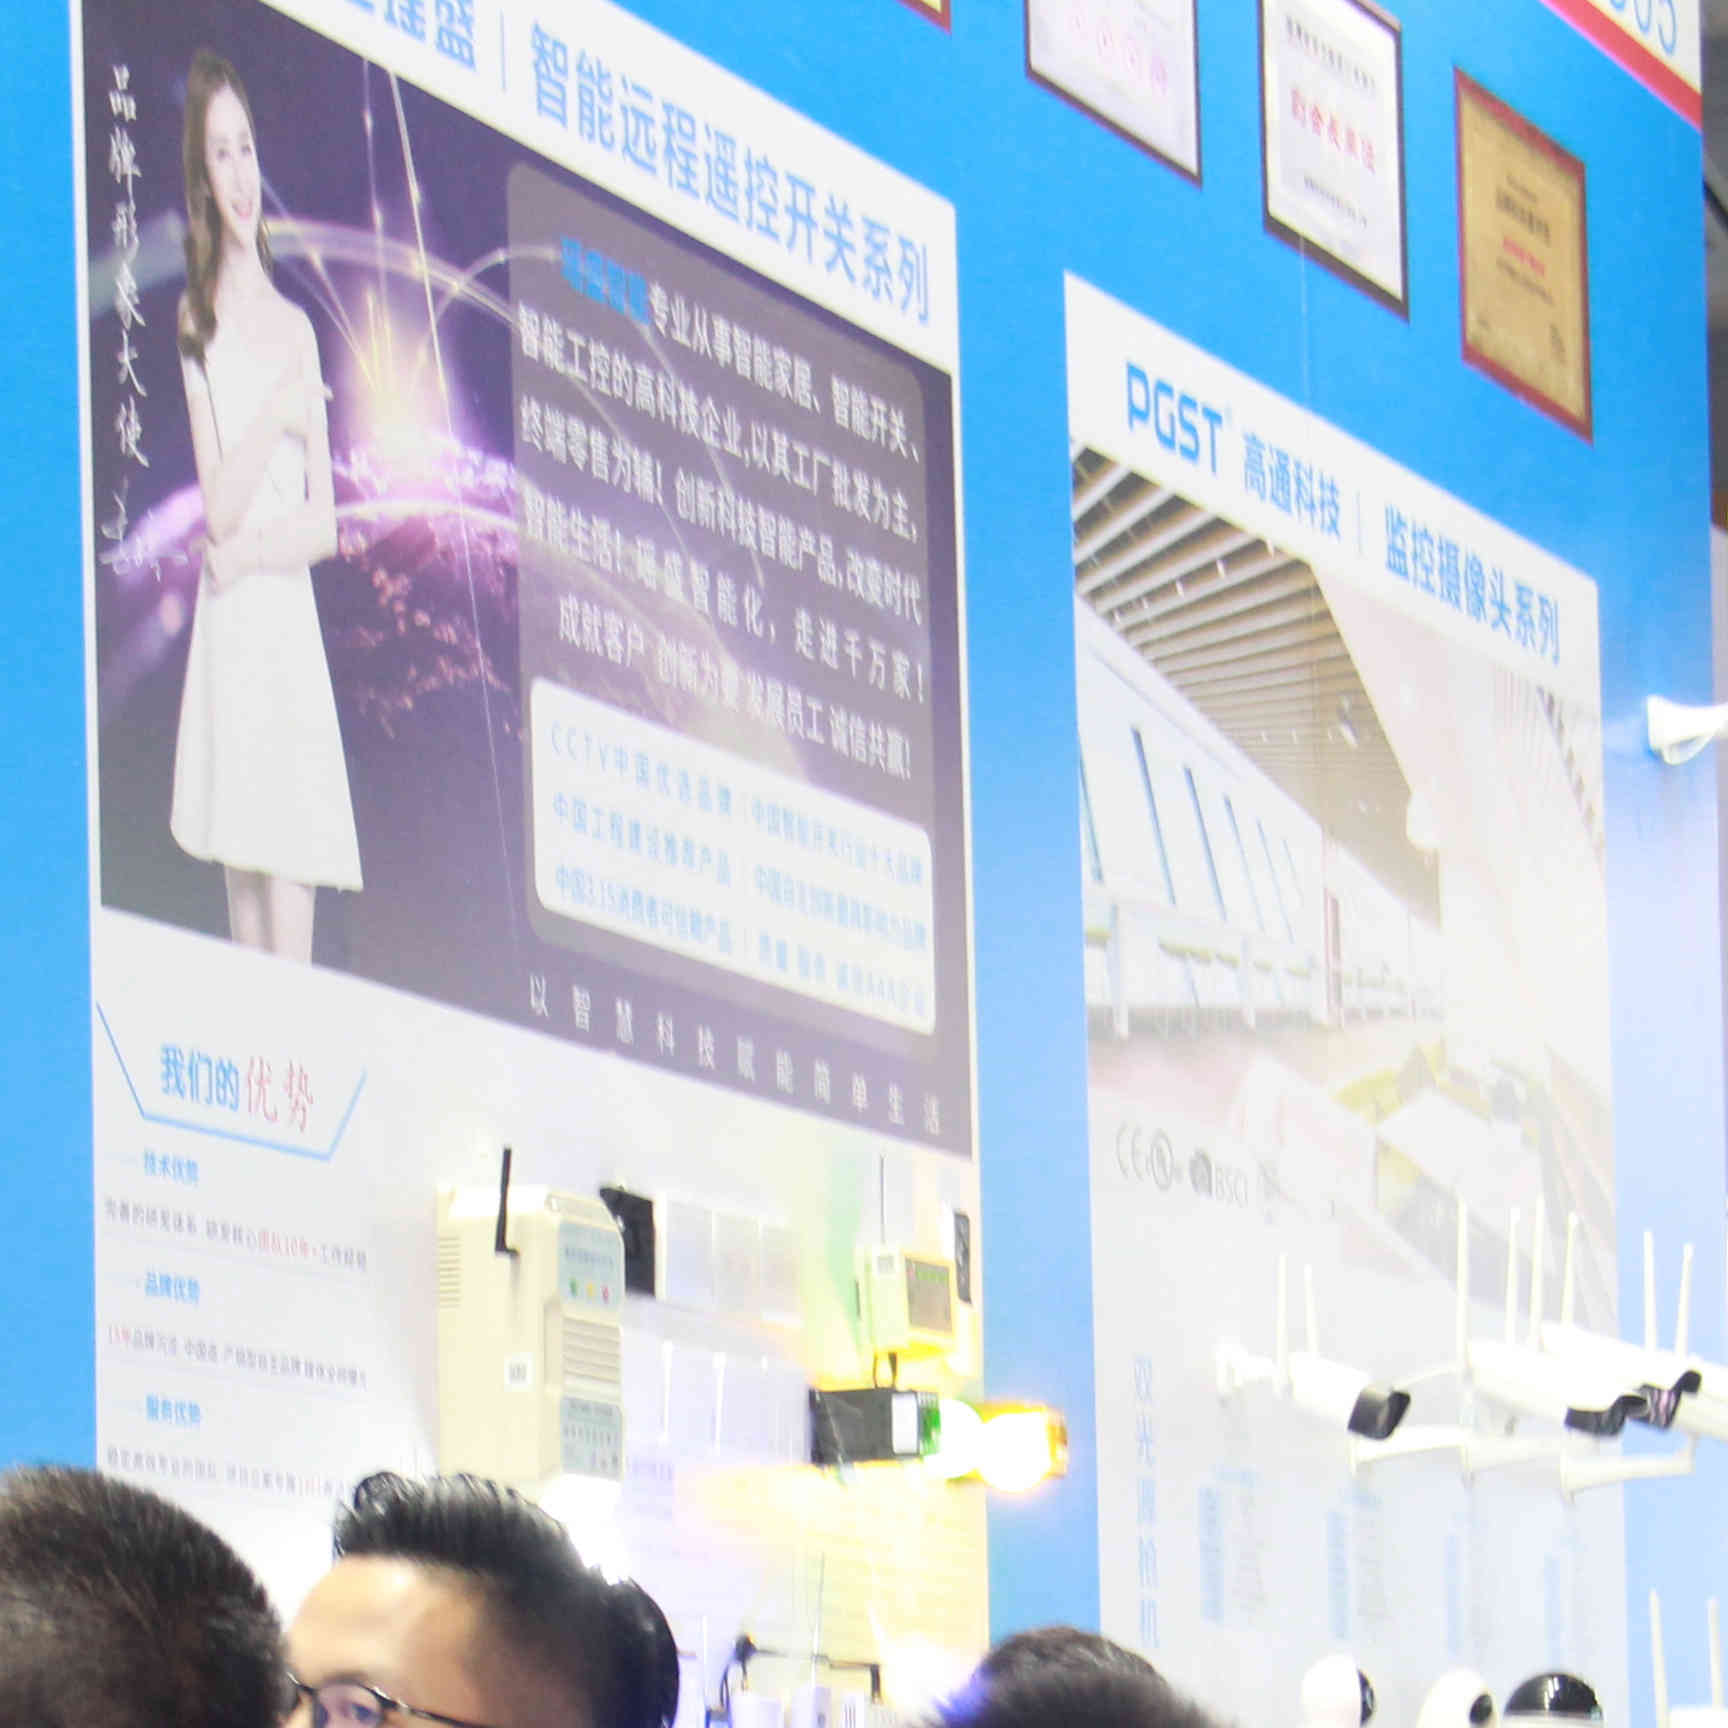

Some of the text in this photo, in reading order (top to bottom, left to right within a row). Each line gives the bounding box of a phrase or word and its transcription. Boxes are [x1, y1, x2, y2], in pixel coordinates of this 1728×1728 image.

[529, 21, 930, 326] 智能远程遥控开关系列
[1126, 361, 1561, 666] PGST 高通科技 监控摄像头系列
[159, 1043, 315, 1133] 我们的优势
[143, 1149, 200, 1186] 技术优势
[143, 1268, 201, 1304] 品牌优势
